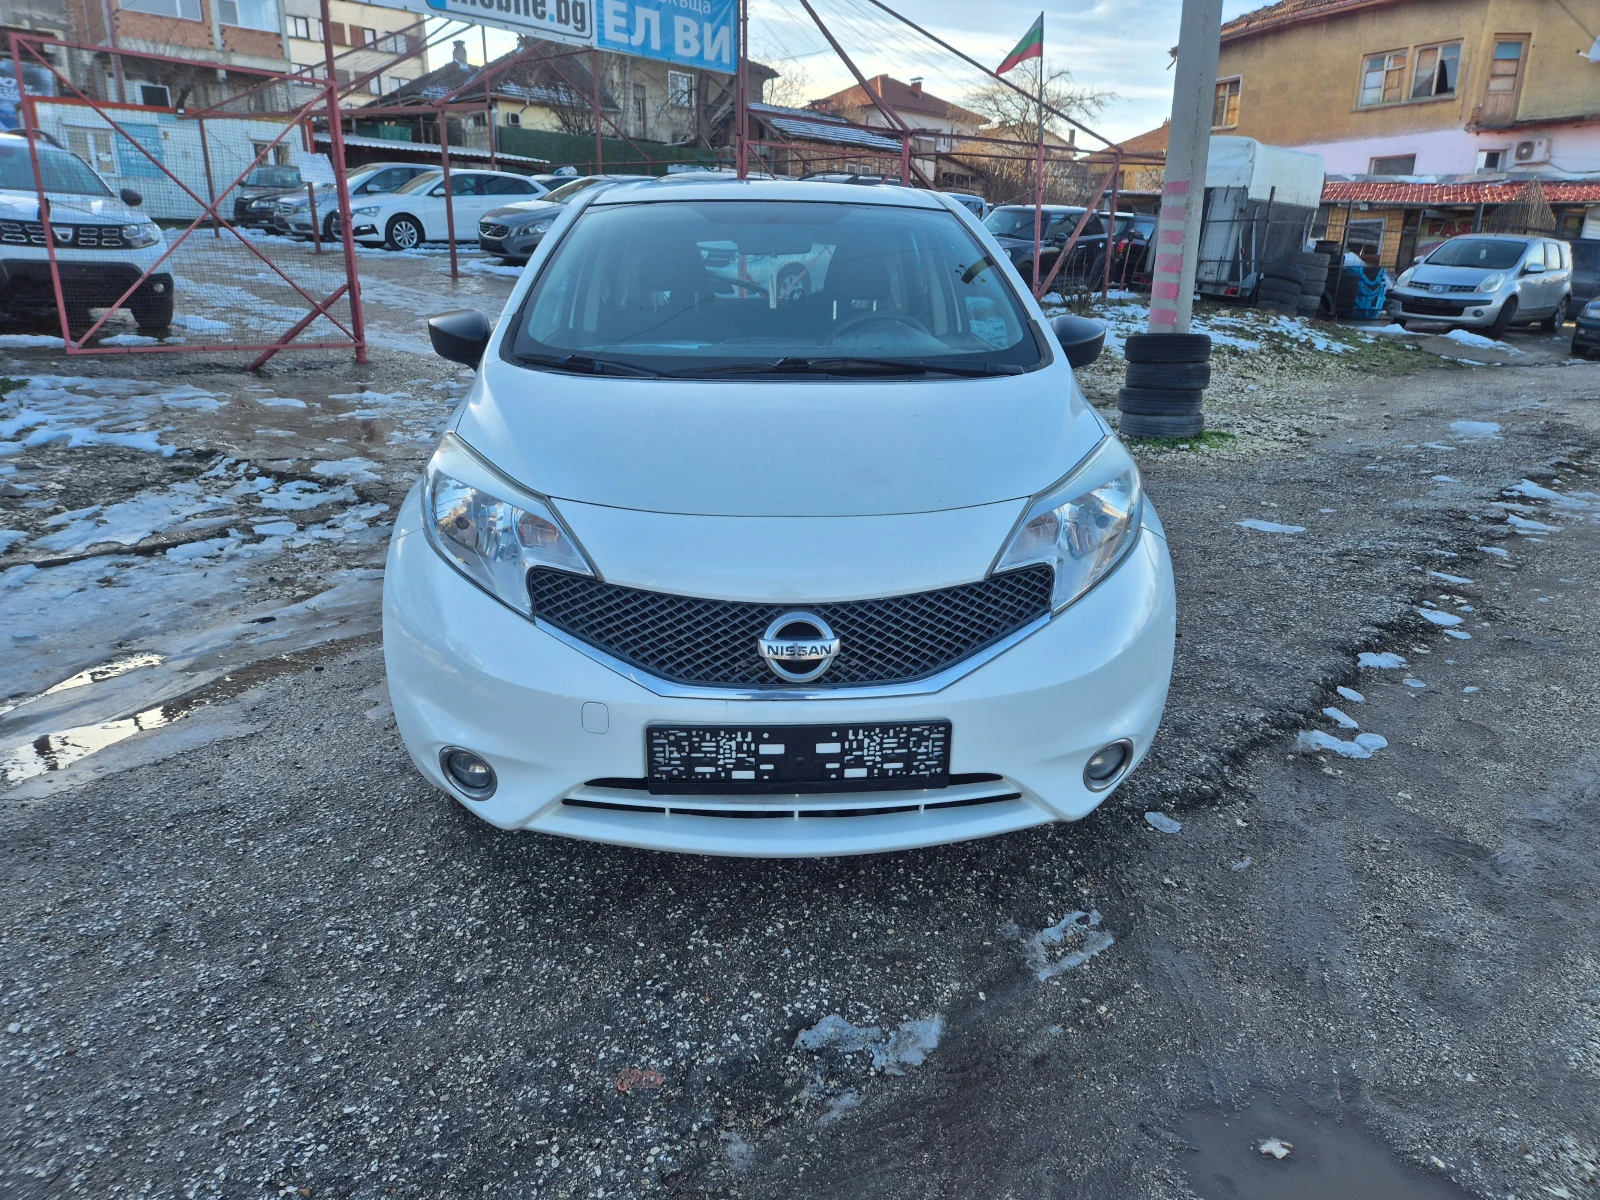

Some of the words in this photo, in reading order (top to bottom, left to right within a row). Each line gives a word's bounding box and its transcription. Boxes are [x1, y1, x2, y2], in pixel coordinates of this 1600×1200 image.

[603, 0, 660, 50] ЕЛ
[674, 15, 730, 64] ВИ
[1428, 221, 1473, 237] FAS
[767, 644, 832, 656] NISSAN
